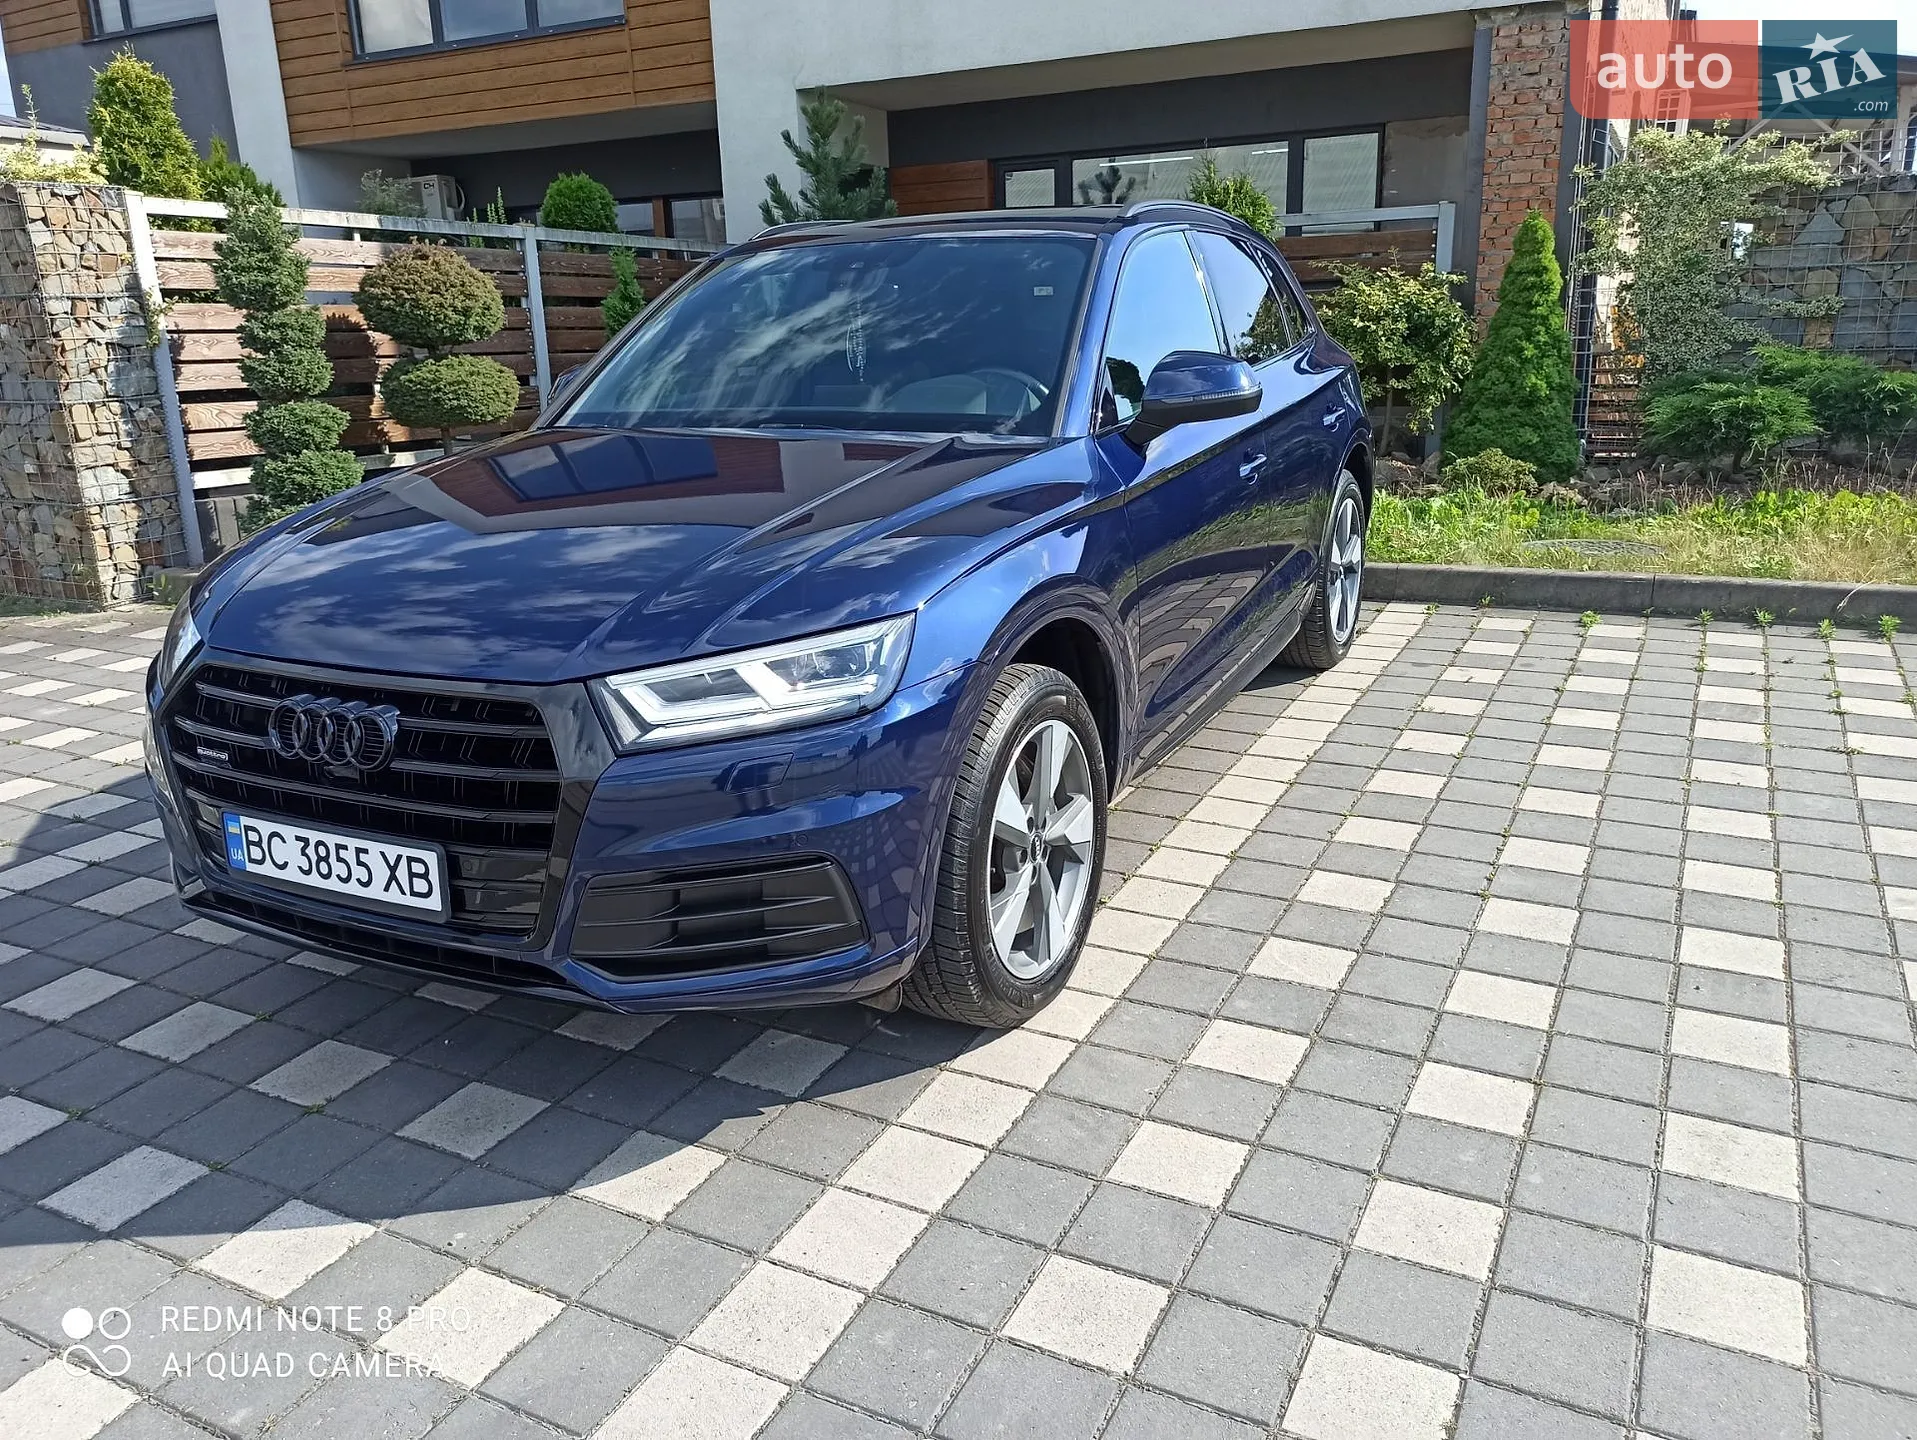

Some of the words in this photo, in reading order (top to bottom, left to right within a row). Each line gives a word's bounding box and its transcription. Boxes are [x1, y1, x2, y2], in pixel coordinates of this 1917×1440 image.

[231, 847, 245, 861] UA
[243, 824, 289, 871] BC
[294, 834, 373, 888] 3855
[379, 850, 434, 899] XB
